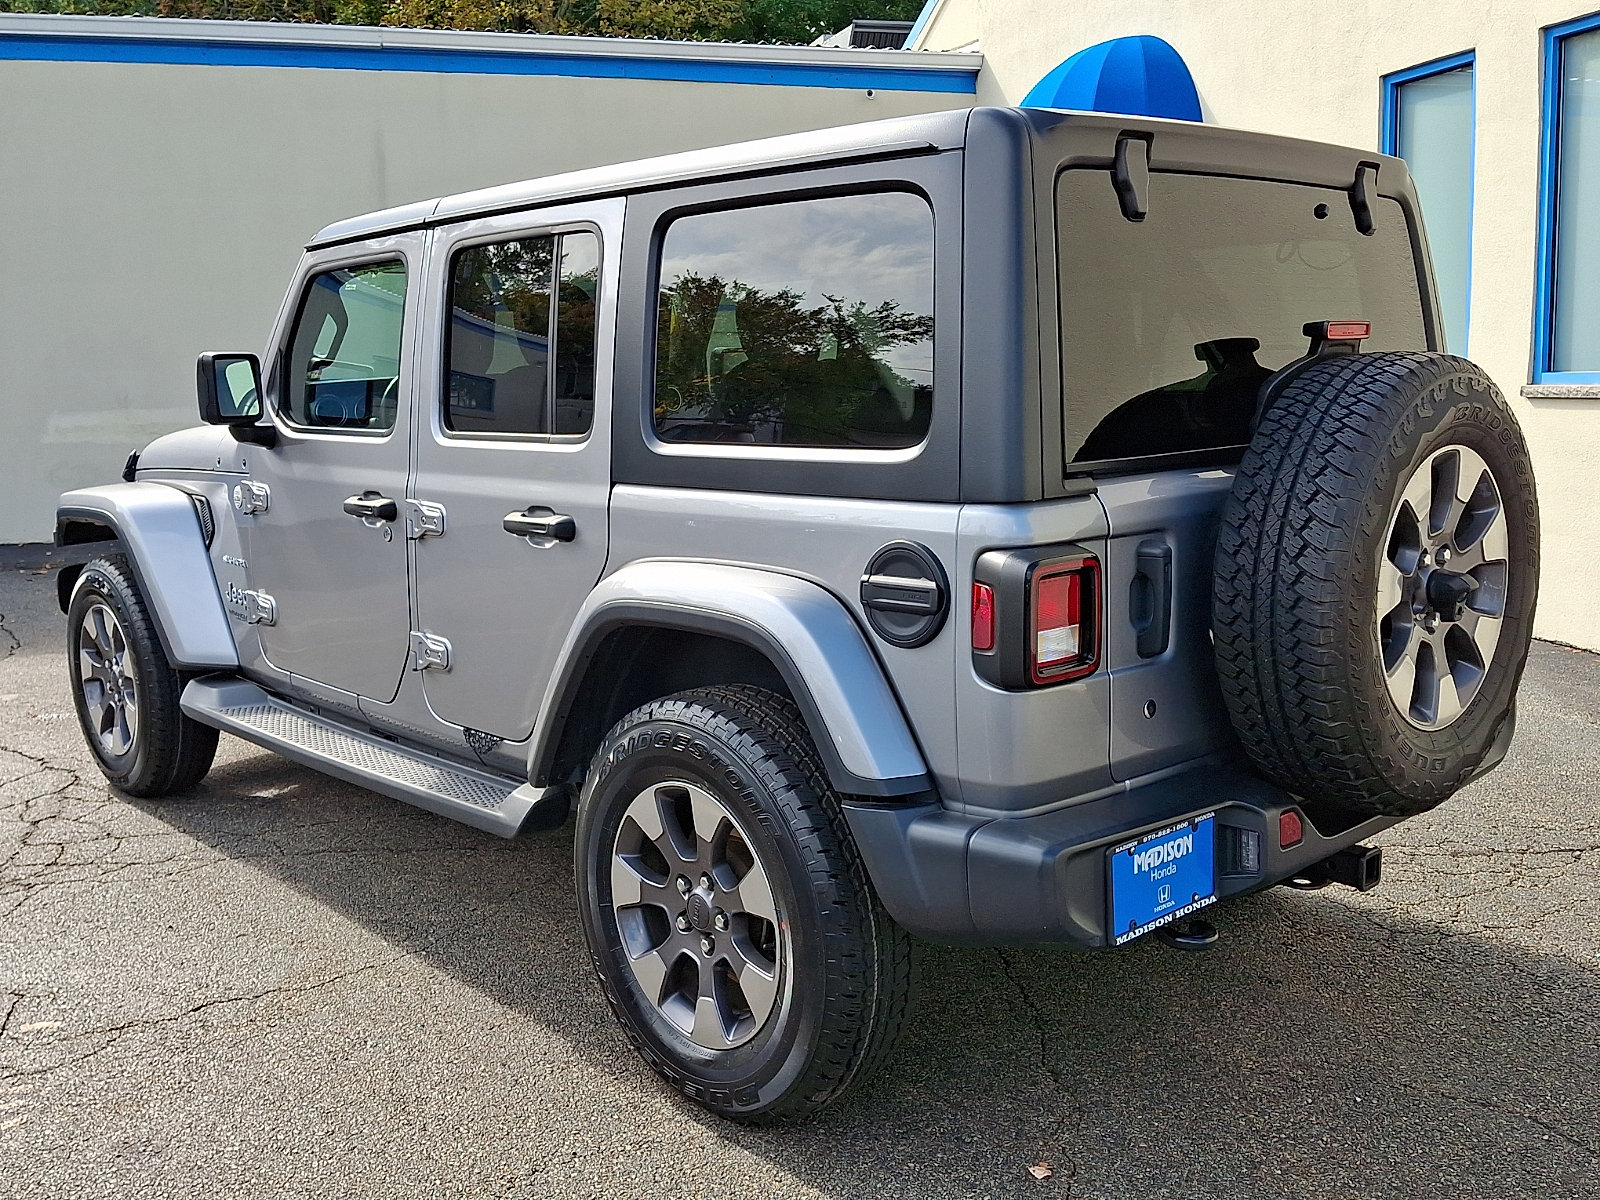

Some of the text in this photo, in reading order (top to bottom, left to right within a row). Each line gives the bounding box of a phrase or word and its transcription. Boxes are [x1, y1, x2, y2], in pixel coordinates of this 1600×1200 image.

[1452, 402, 1539, 569] BRIDGESTONE
[599, 729, 781, 837] BRIDGESTONE
[1194, 811, 1216, 824] HONDA
[1133, 833, 1193, 875] MADISON
[1150, 862, 1177, 883] Honda
[1115, 895, 1218, 946] MADISON HONDA
[1153, 900, 1176, 914] HONDA
